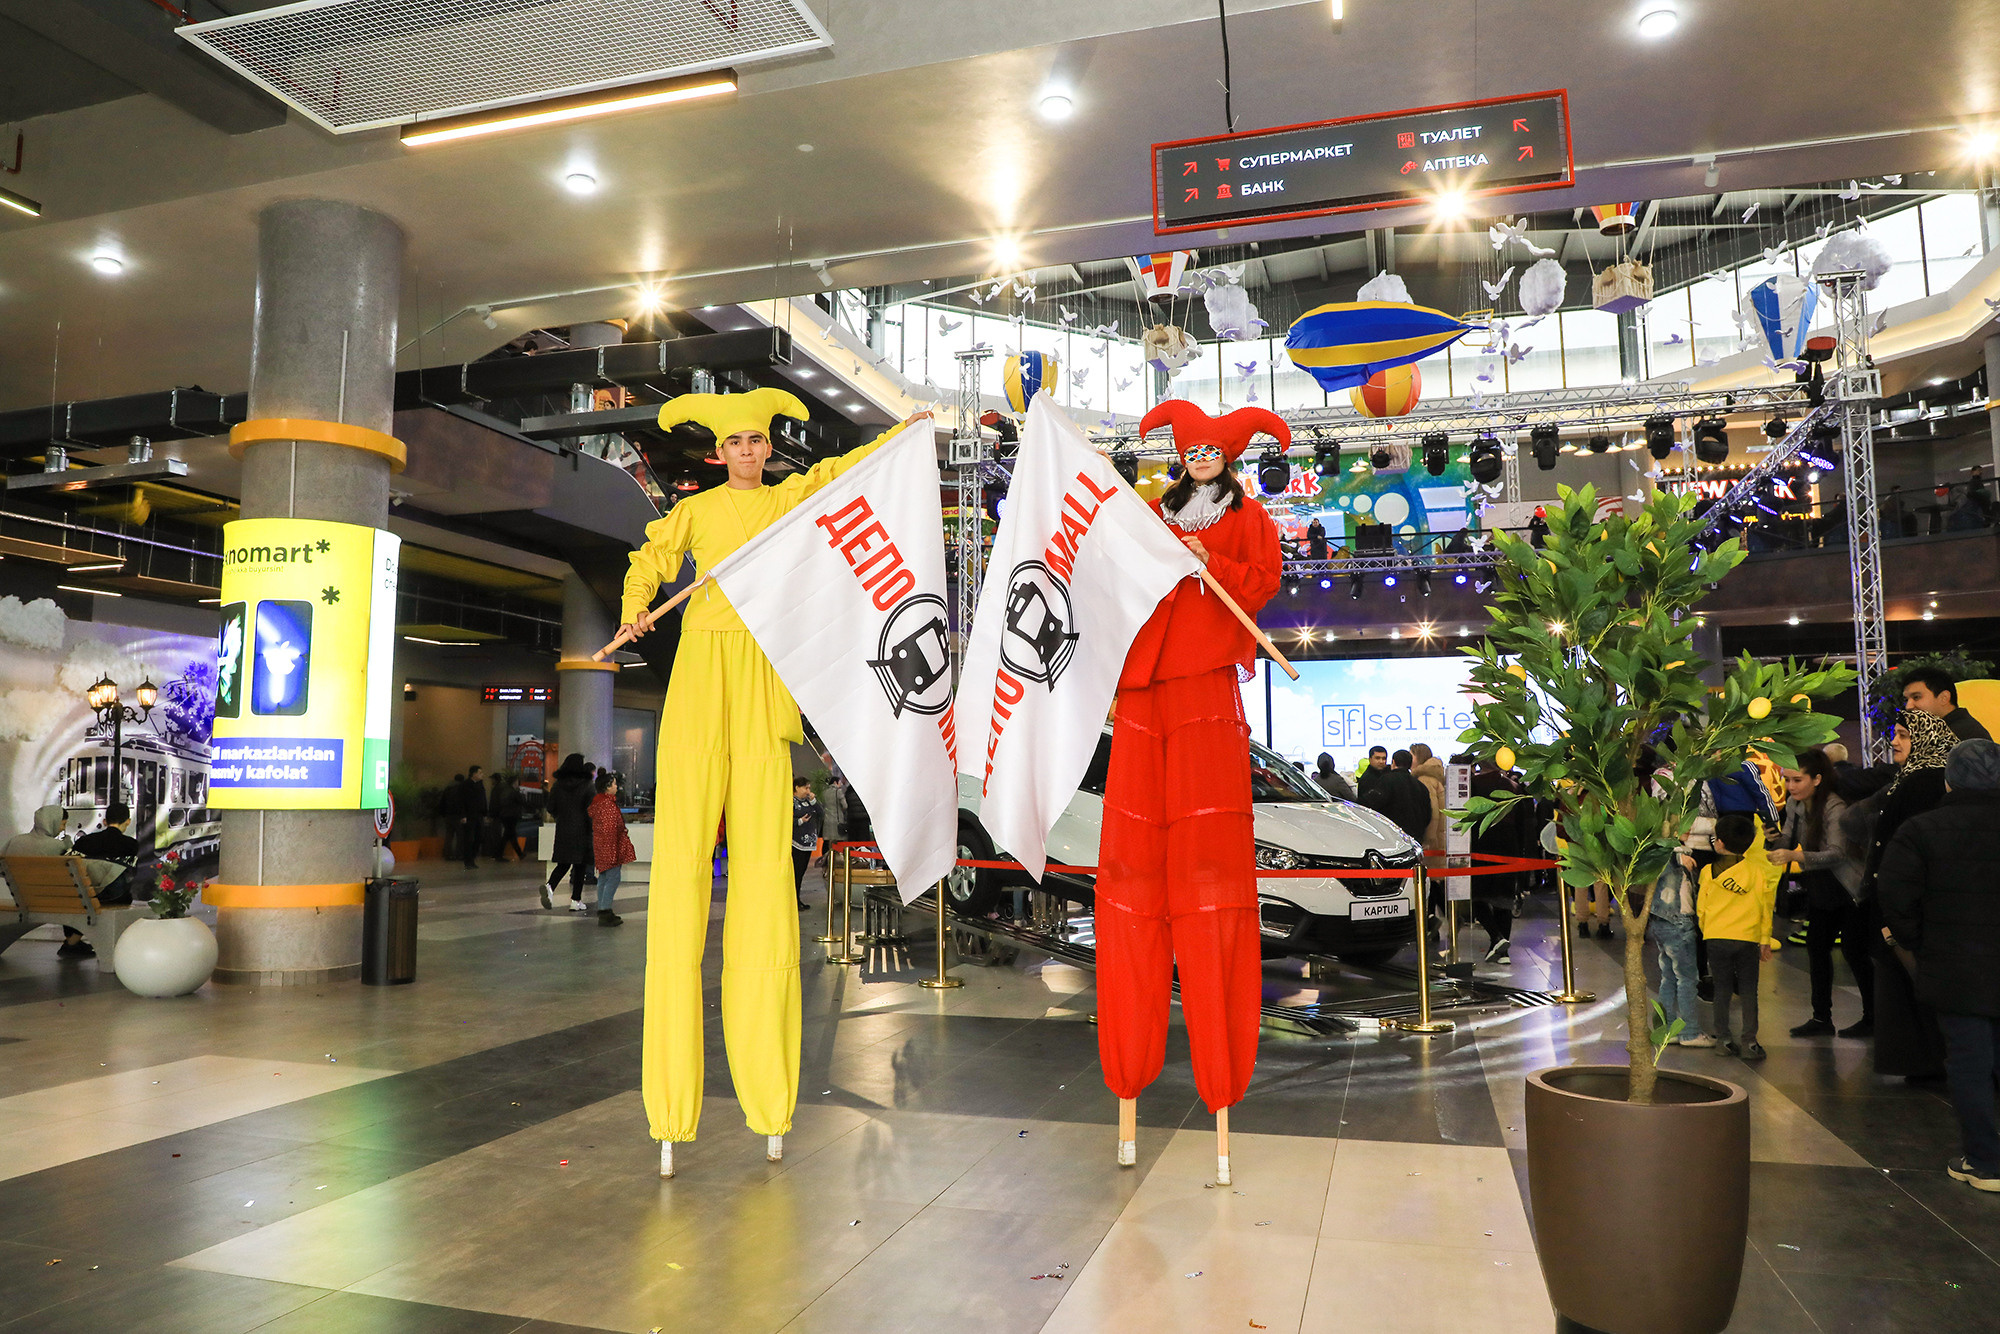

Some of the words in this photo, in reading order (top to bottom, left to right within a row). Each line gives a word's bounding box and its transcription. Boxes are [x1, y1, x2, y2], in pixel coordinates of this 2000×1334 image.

[1420, 126, 1482, 144] ТУАЛЕТ
[1239, 143, 1353, 169] СУПЕРМАРКЕТ
[1423, 153, 1489, 172] АПТЕКА
[1241, 179, 1285, 196] БАНК
[1044, 471, 1119, 587] MALL
[815, 495, 916, 611] ДЕПО
[1368, 705, 1471, 732] selfie
[246, 765, 309, 780] kafolat
[1364, 904, 1399, 916] KAPTUR
